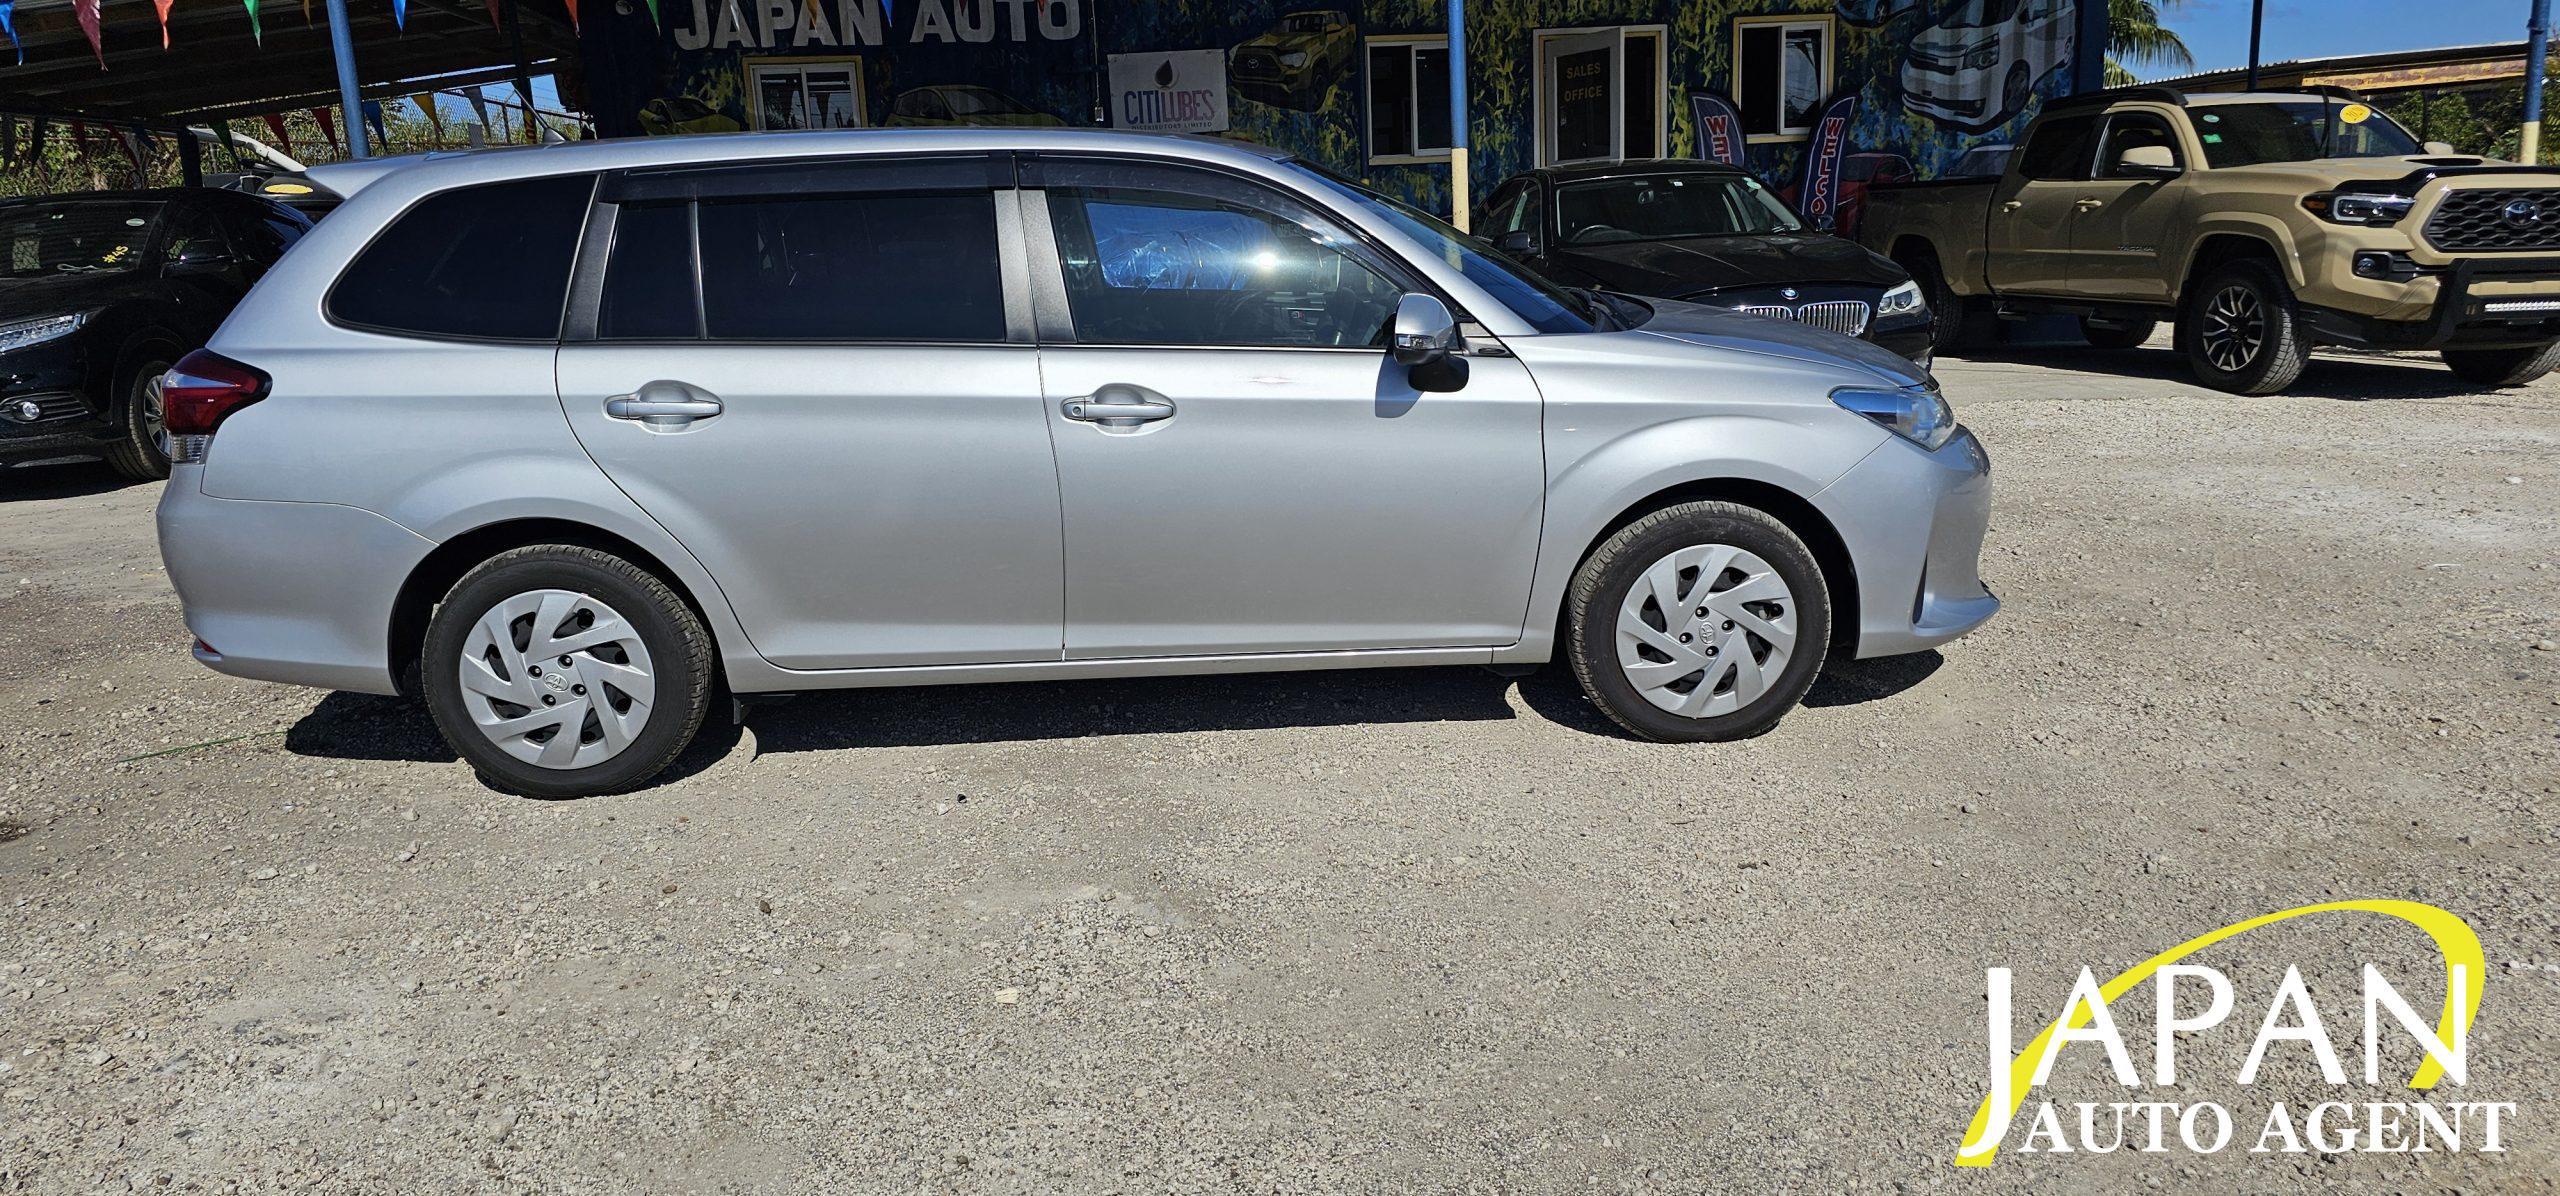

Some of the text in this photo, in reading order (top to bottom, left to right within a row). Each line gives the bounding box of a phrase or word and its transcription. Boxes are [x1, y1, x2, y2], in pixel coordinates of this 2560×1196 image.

[674, 0, 1081, 51] JAPAN AUTO
[1566, 61, 1602, 80] SALES
[1563, 84, 1603, 102] OFFICE
[1124, 90, 1215, 124] CITILUBES
